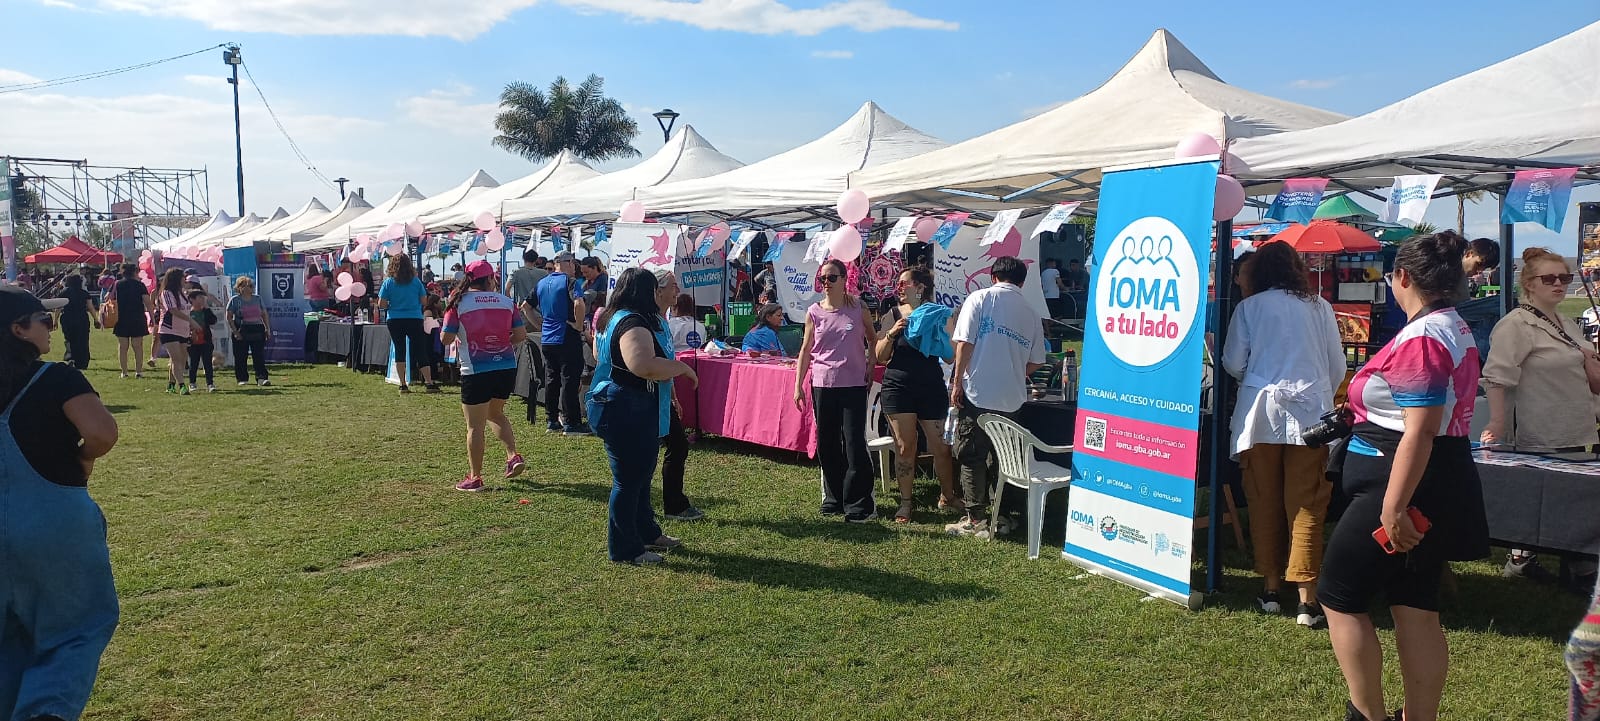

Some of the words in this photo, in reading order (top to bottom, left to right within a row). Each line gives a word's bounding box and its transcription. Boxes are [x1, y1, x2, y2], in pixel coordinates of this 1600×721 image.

[1108, 277, 1180, 312] IOMA
[1105, 316, 1115, 333] a
[1117, 312, 1137, 335] tu
[1138, 311, 1179, 339] lado
[1084, 387, 1119, 402] CERCANÍA,
[1120, 393, 1148, 406] ACCESO
[1149, 398, 1155, 407] Y
[1155, 399, 1194, 414] CUIDADO
[1115, 439, 1171, 460] ioma.gba.gob.ar
[1070, 509, 1094, 527] IOMA
